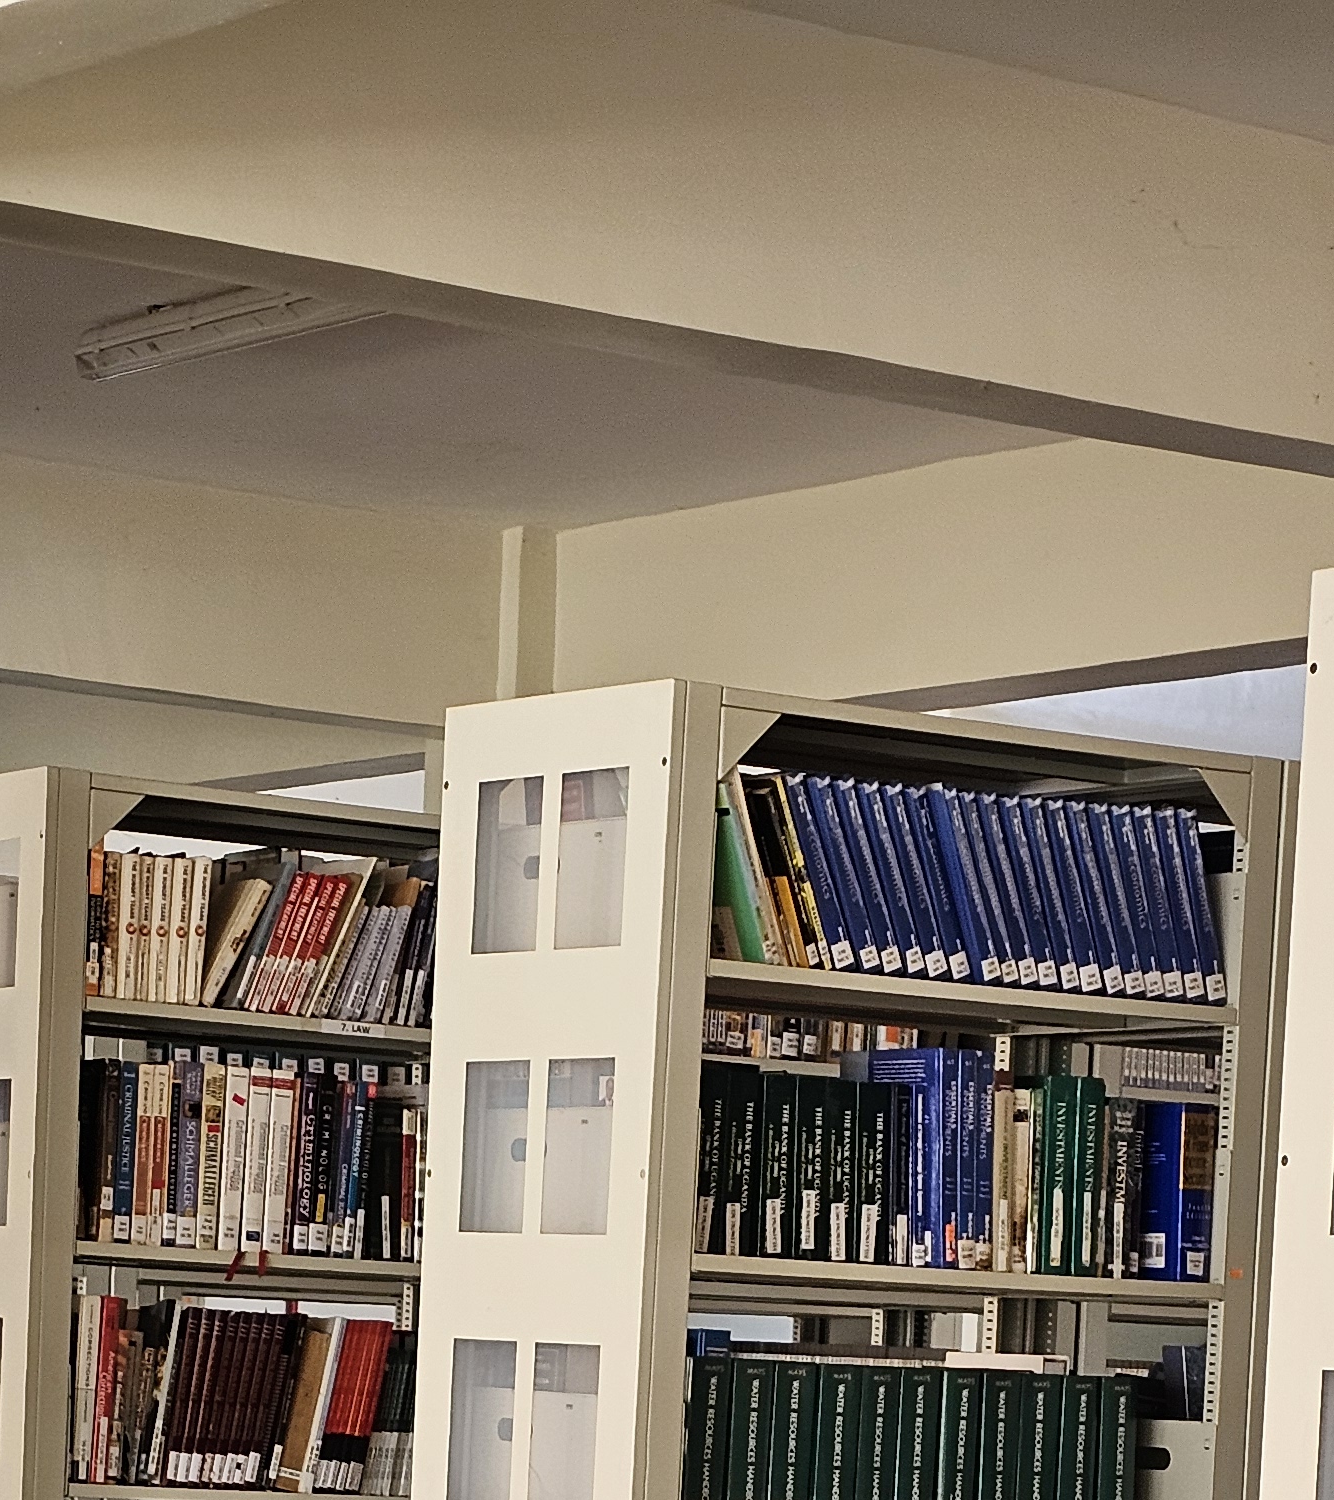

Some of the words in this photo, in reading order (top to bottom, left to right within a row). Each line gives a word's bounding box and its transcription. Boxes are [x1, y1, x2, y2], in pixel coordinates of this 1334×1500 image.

[332, 883, 347, 908] SPECIAL
[1128, 856, 1146, 929] Economics
[341, 1023, 349, 1031] 7.
[352, 1024, 371, 1034] LAW
[746, 1102, 754, 1121] THE
[744, 1123, 752, 1150] BANK
[781, 1125, 789, 1152] BANK
[814, 1128, 822, 1155] BANK
[843, 1131, 851, 1158] BANK
[1054, 1102, 1066, 1190] INVESTMENTS
[1084, 1104, 1096, 1191] INVESTMENTS
[182, 1121, 196, 1207] SCHMALLEGER
[299, 1115, 315, 1217] Criminology
[743, 1153, 751, 1167] OF
[780, 1155, 788, 1169] OF
[814, 1157, 822, 1171] OF
[843, 1160, 850, 1173] OF
[740, 1169, 751, 1212] UGANDA
[709, 1376, 717, 1405] WATER
[750, 1379, 760, 1408] WATER
[836, 1384, 845, 1413] WATER
[960, 1388, 969, 1417] WATER
[1079, 1393, 1087, 1422] WATER
[704, 1409, 715, 1460] RESOURCES
[747, 1412, 758, 1463] RESOURCES
[833, 1416, 843, 1466] RESOURCES
[957, 1420, 966, 1469] RESOURCES
[1076, 1425, 1085, 1473] RESOURCES
